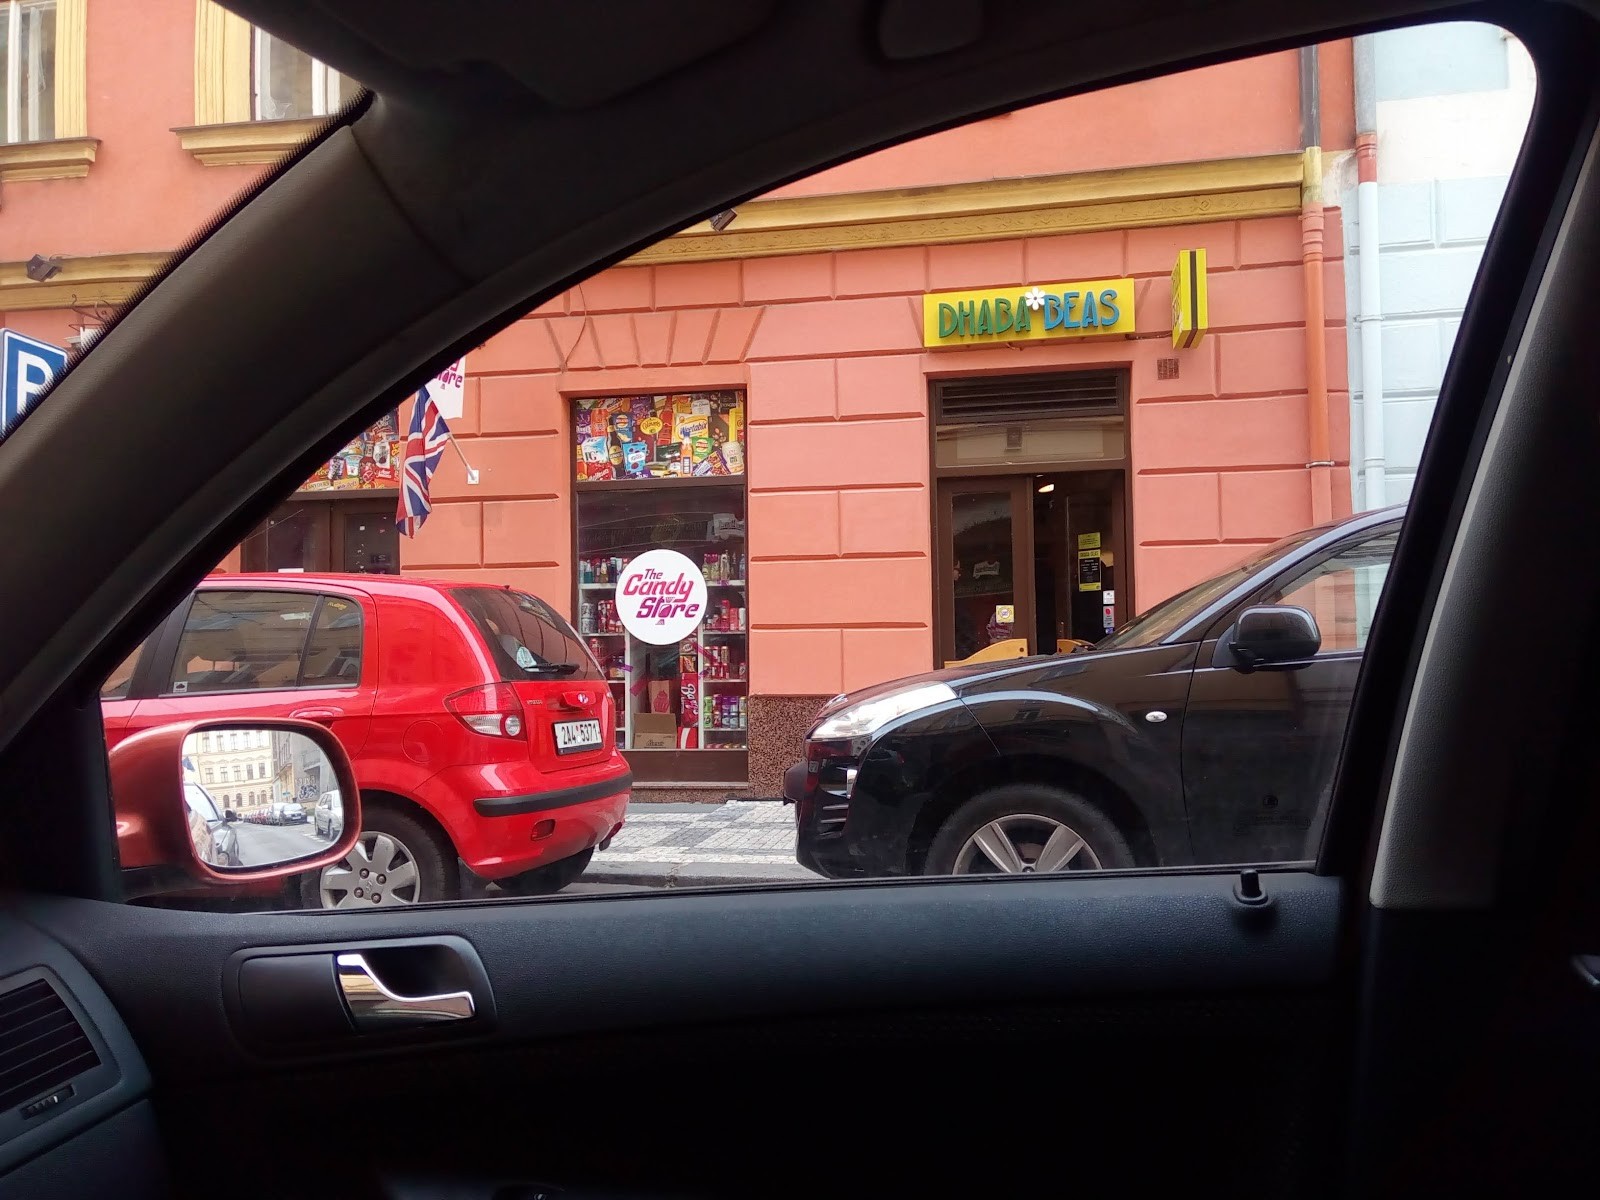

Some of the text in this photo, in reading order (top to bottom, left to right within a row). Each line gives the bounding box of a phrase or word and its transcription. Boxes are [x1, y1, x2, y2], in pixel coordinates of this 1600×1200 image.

[938, 289, 1121, 338] DHABA BEAS
[17, 350, 54, 416] P
[644, 568, 663, 580] The
[623, 573, 694, 603] Candy
[636, 596, 700, 618] Store
[561, 722, 599, 745] 2A4 5371
